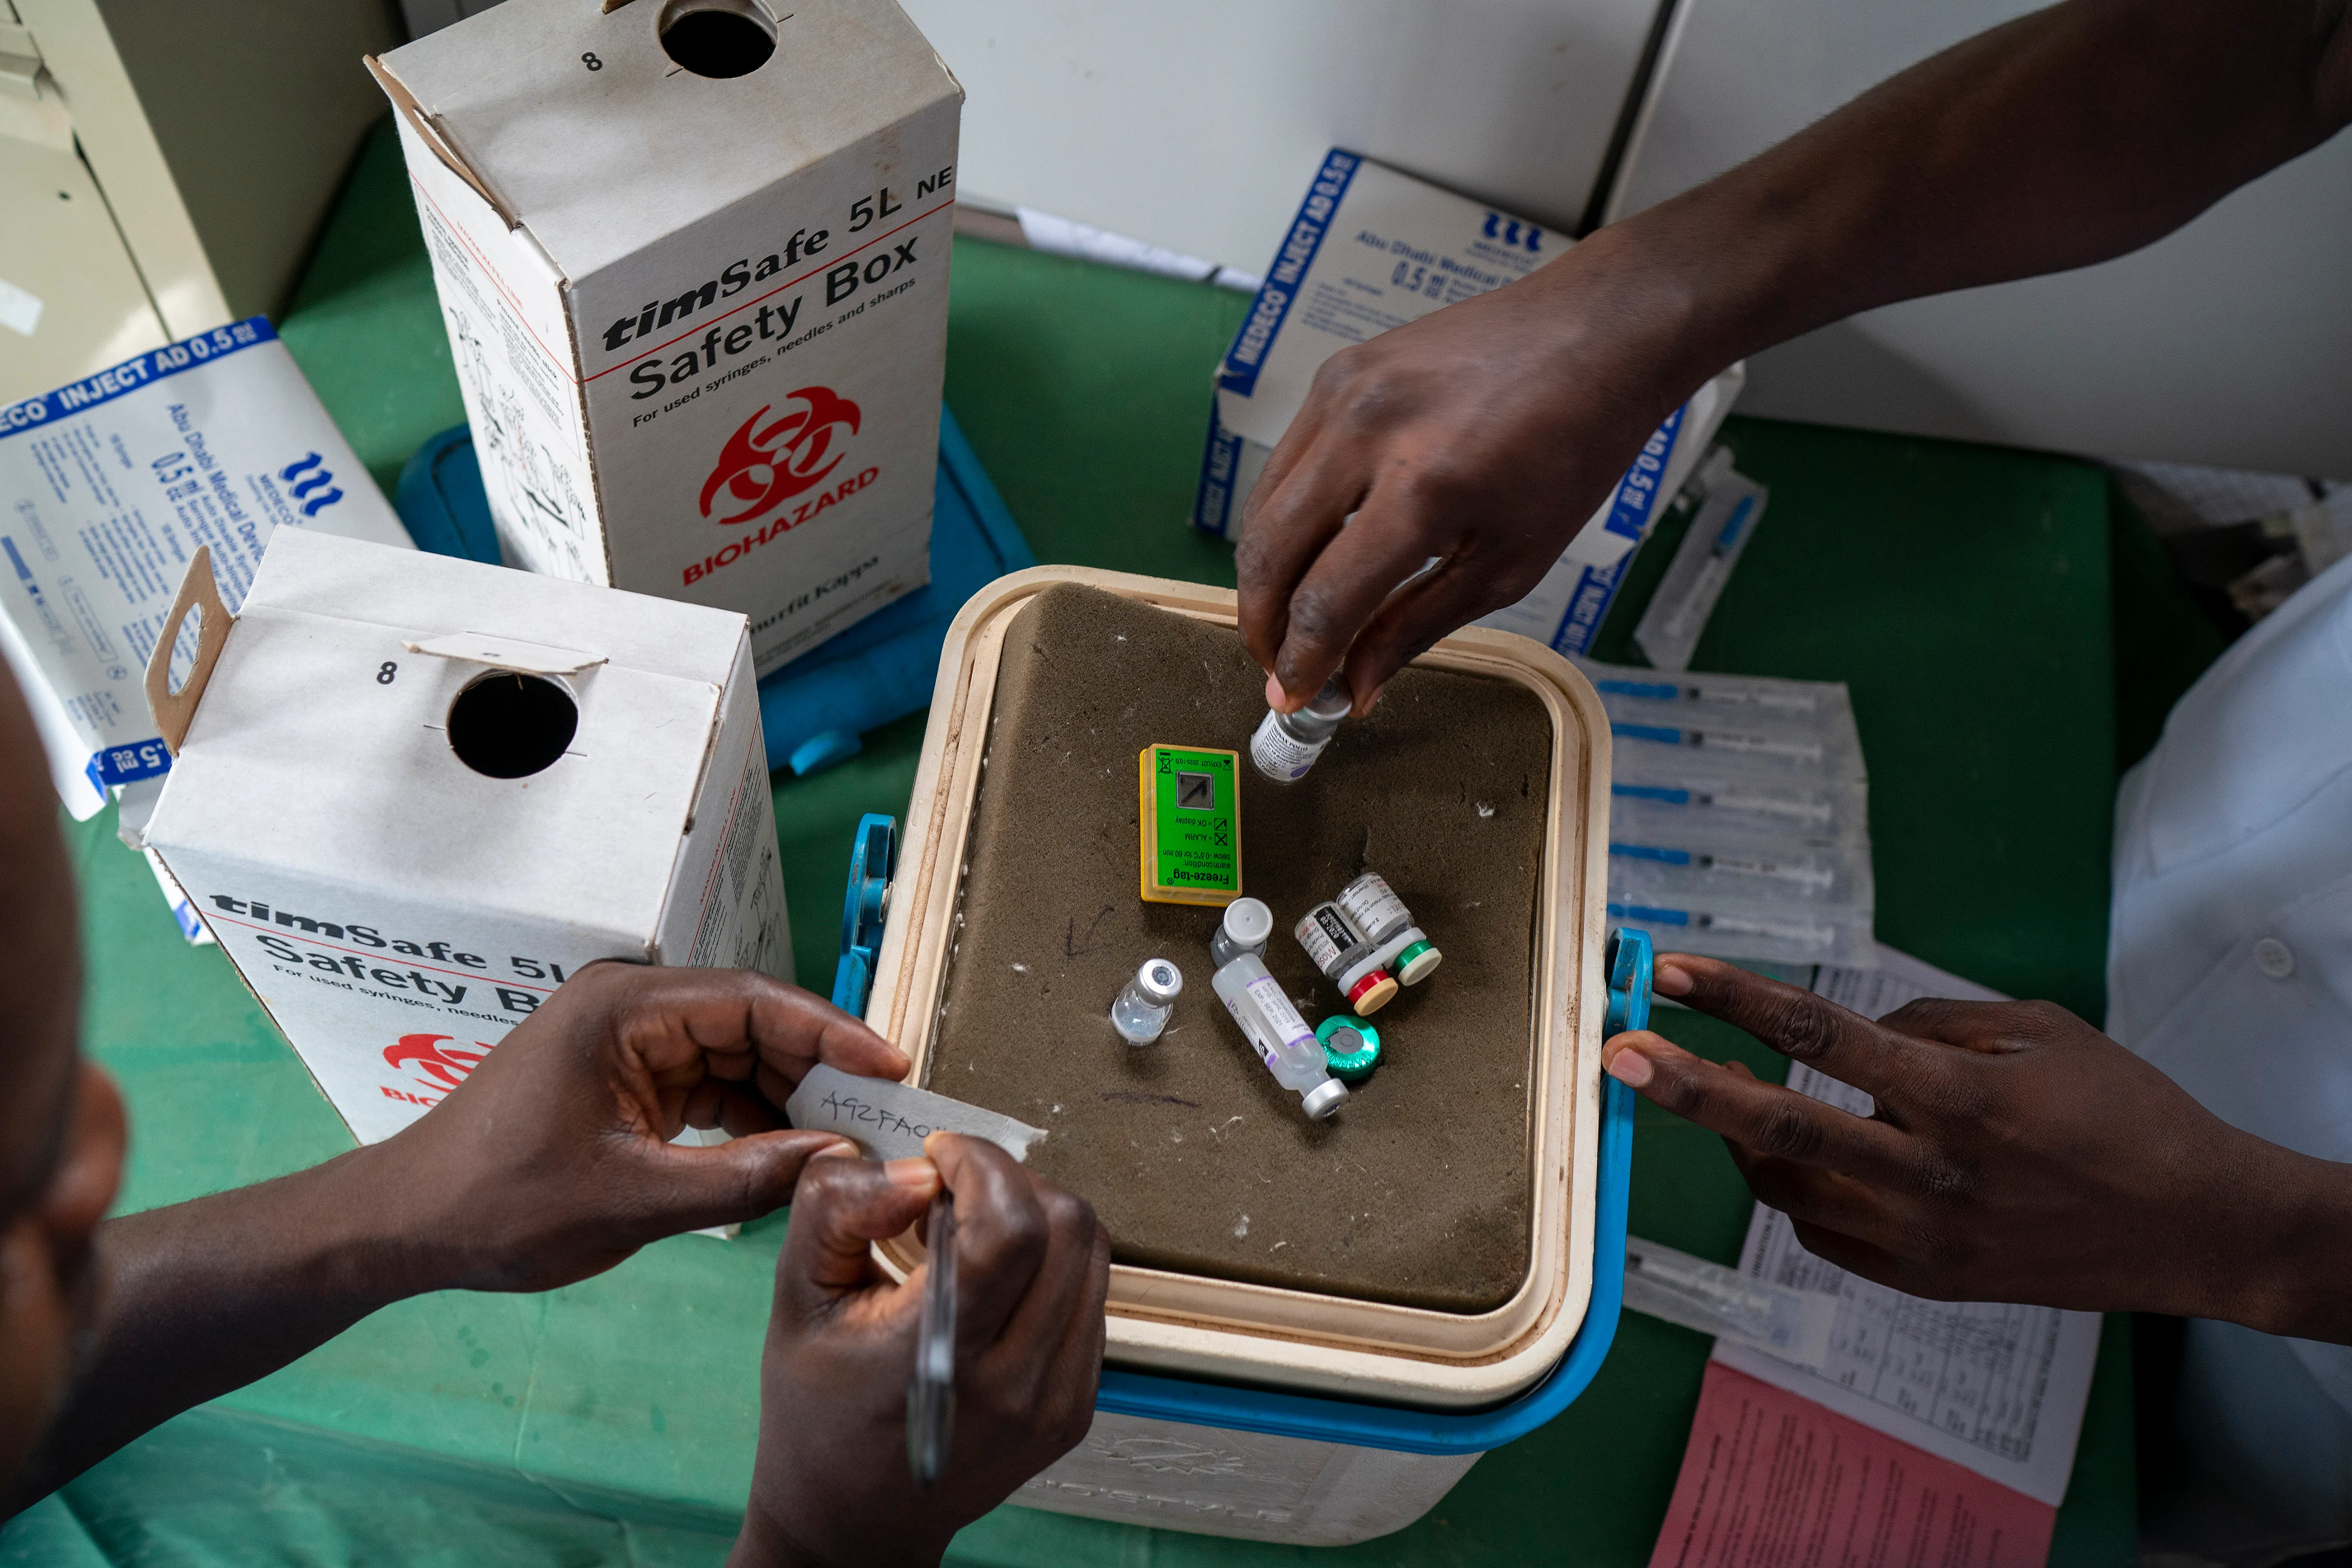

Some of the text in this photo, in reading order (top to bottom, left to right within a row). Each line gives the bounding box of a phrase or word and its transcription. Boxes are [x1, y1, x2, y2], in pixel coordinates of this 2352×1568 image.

[581, 51, 603, 71] 8
[602, 166, 954, 351] timSafe 5L NE
[629, 295, 803, 400] Safety
[825, 236, 919, 307] Box
[59, 358, 149, 410] INJECT
[155, 342, 191, 373] AD
[191, 329, 232, 360] 0.5
[632, 277, 916, 428] For used syringes, needles and sharps
[167, 400, 195, 434] Abu
[183, 429, 218, 473] Dhabi
[207, 467, 249, 525] Medical
[683, 466, 880, 587] BIOHAZARD
[376, 661, 397, 685] 8
[1175, 816, 1196, 825] display
[1185, 833, 1207, 841] ALARM
[1213, 853, 1230, 861] below
[1214, 862, 1230, 870] alarm
[209, 895, 487, 969] timSafe
[256, 935, 467, 1005] Safety
[274, 964, 519, 1026] For used syringes, needles
[821, 1091, 947, 1137] A92FA0
